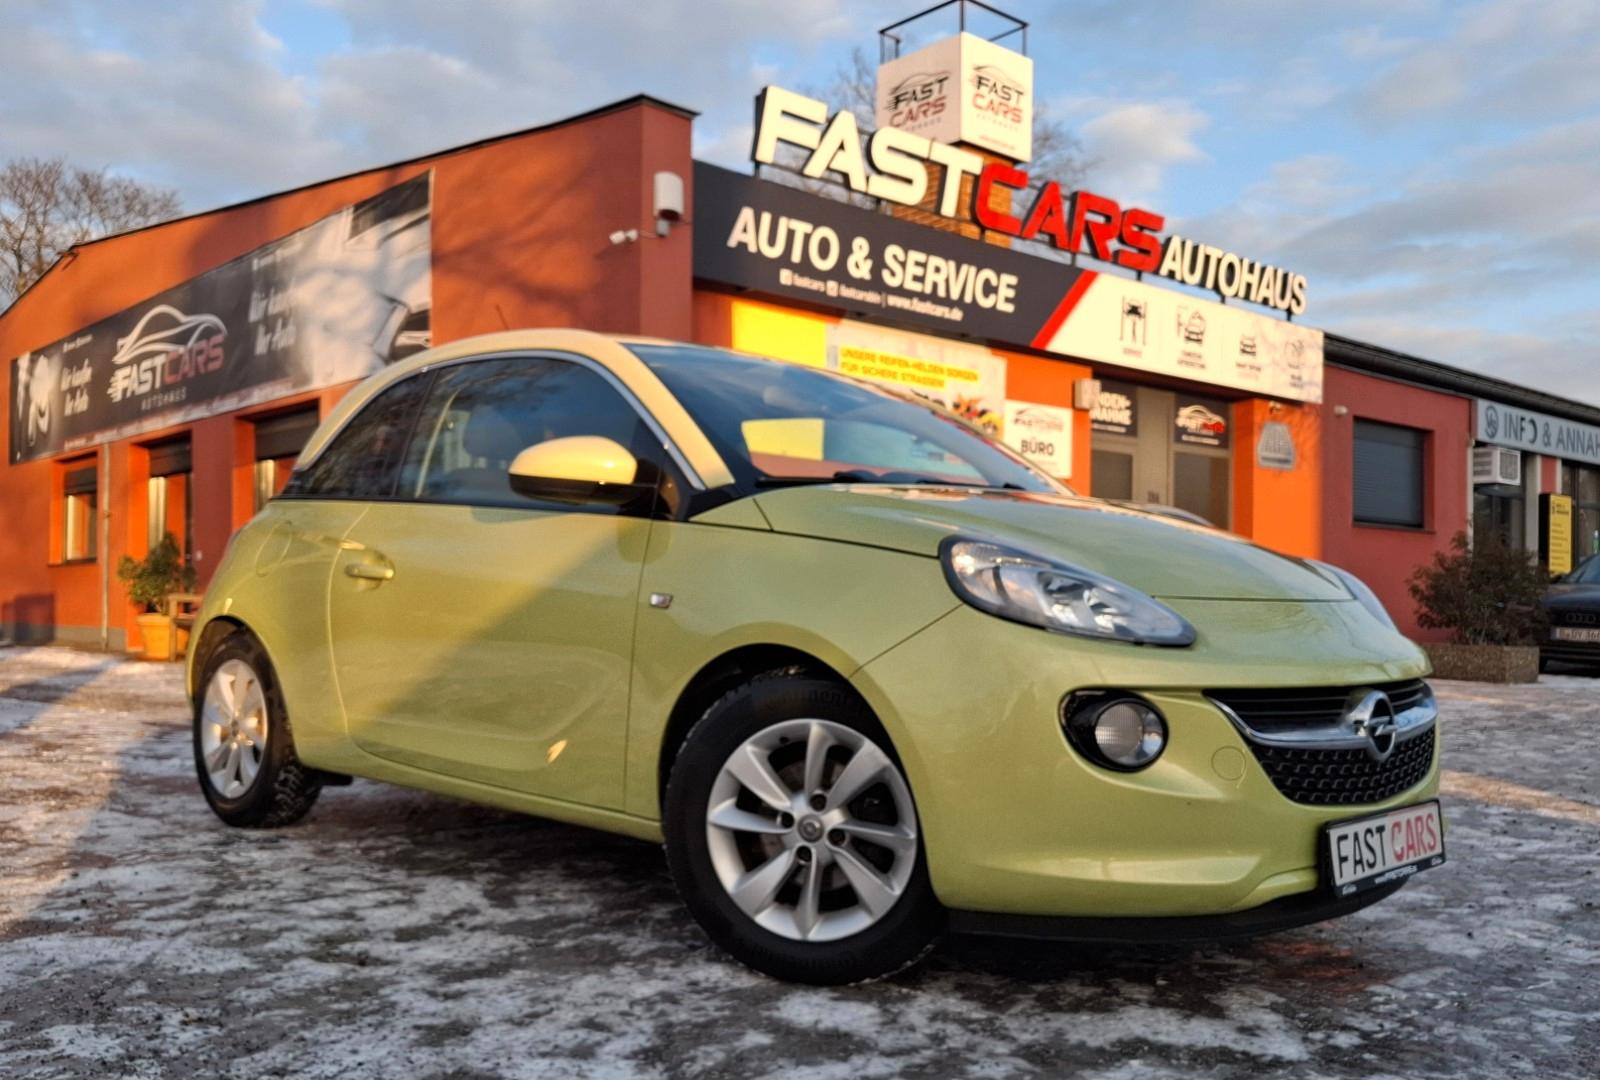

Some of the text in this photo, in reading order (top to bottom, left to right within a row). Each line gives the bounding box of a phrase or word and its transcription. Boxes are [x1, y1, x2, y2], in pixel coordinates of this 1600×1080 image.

[893, 75, 949, 110] FAST
[976, 76, 1024, 106] FAST
[889, 95, 947, 128] CARS
[973, 93, 1023, 124] CARS
[726, 206, 1018, 313] AUTO & SERVICE
[1159, 235, 1307, 315] AUTOHAUS
[840, 348, 876, 364] UNSERE
[947, 367, 978, 383] SORGEN
[862, 364, 899, 379] SICHERE
[1020, 436, 1055, 457] BÜRO
[1542, 422, 1551, 448] &
[1336, 813, 1437, 879] FAST CARS
